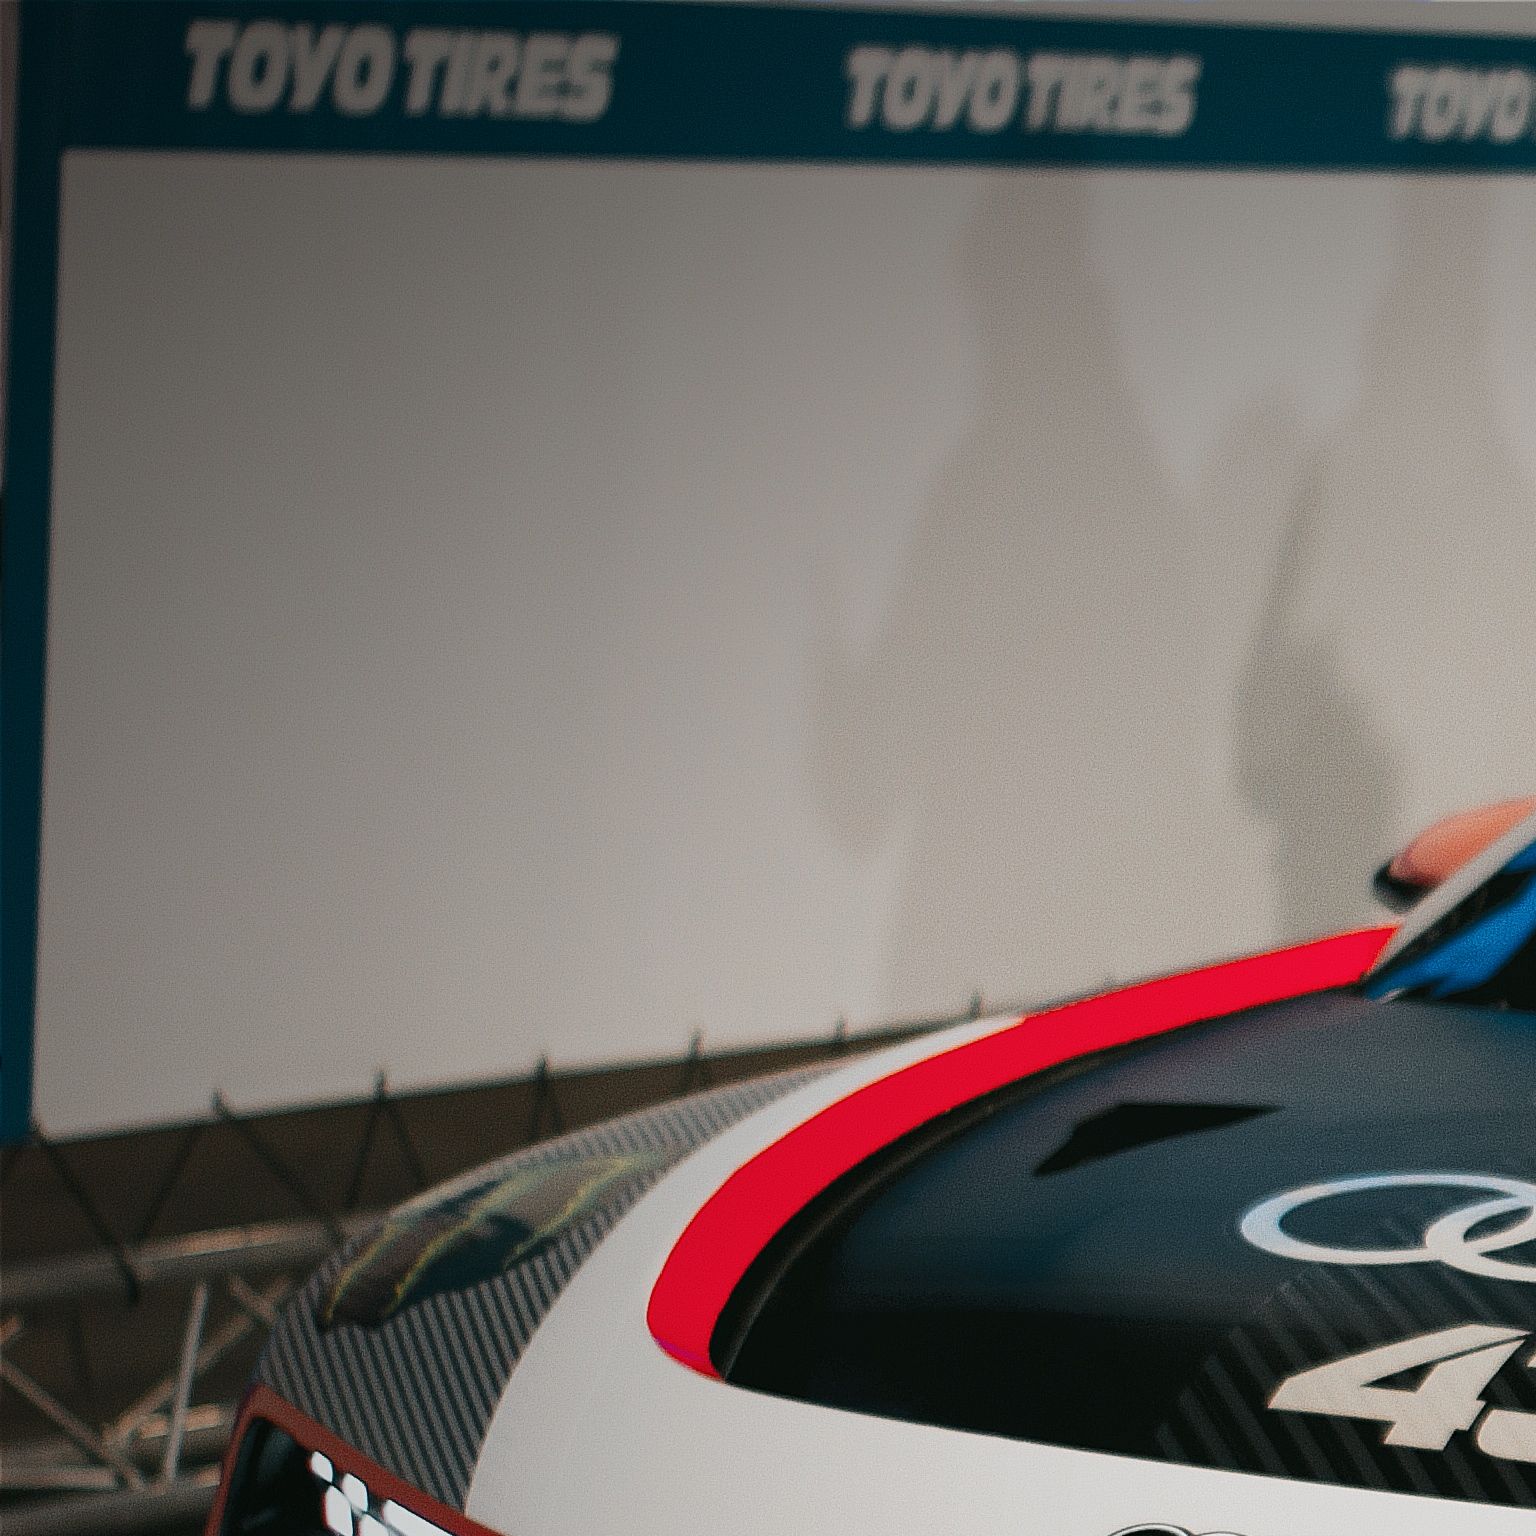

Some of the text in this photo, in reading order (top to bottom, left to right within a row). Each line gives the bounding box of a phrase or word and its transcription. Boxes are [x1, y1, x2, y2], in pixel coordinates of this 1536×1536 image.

[186, 22, 620, 120] TOYO TIRES
[846, 47, 1199, 137] TOYO TIRES
[1391, 66, 1533, 140] TOYO
